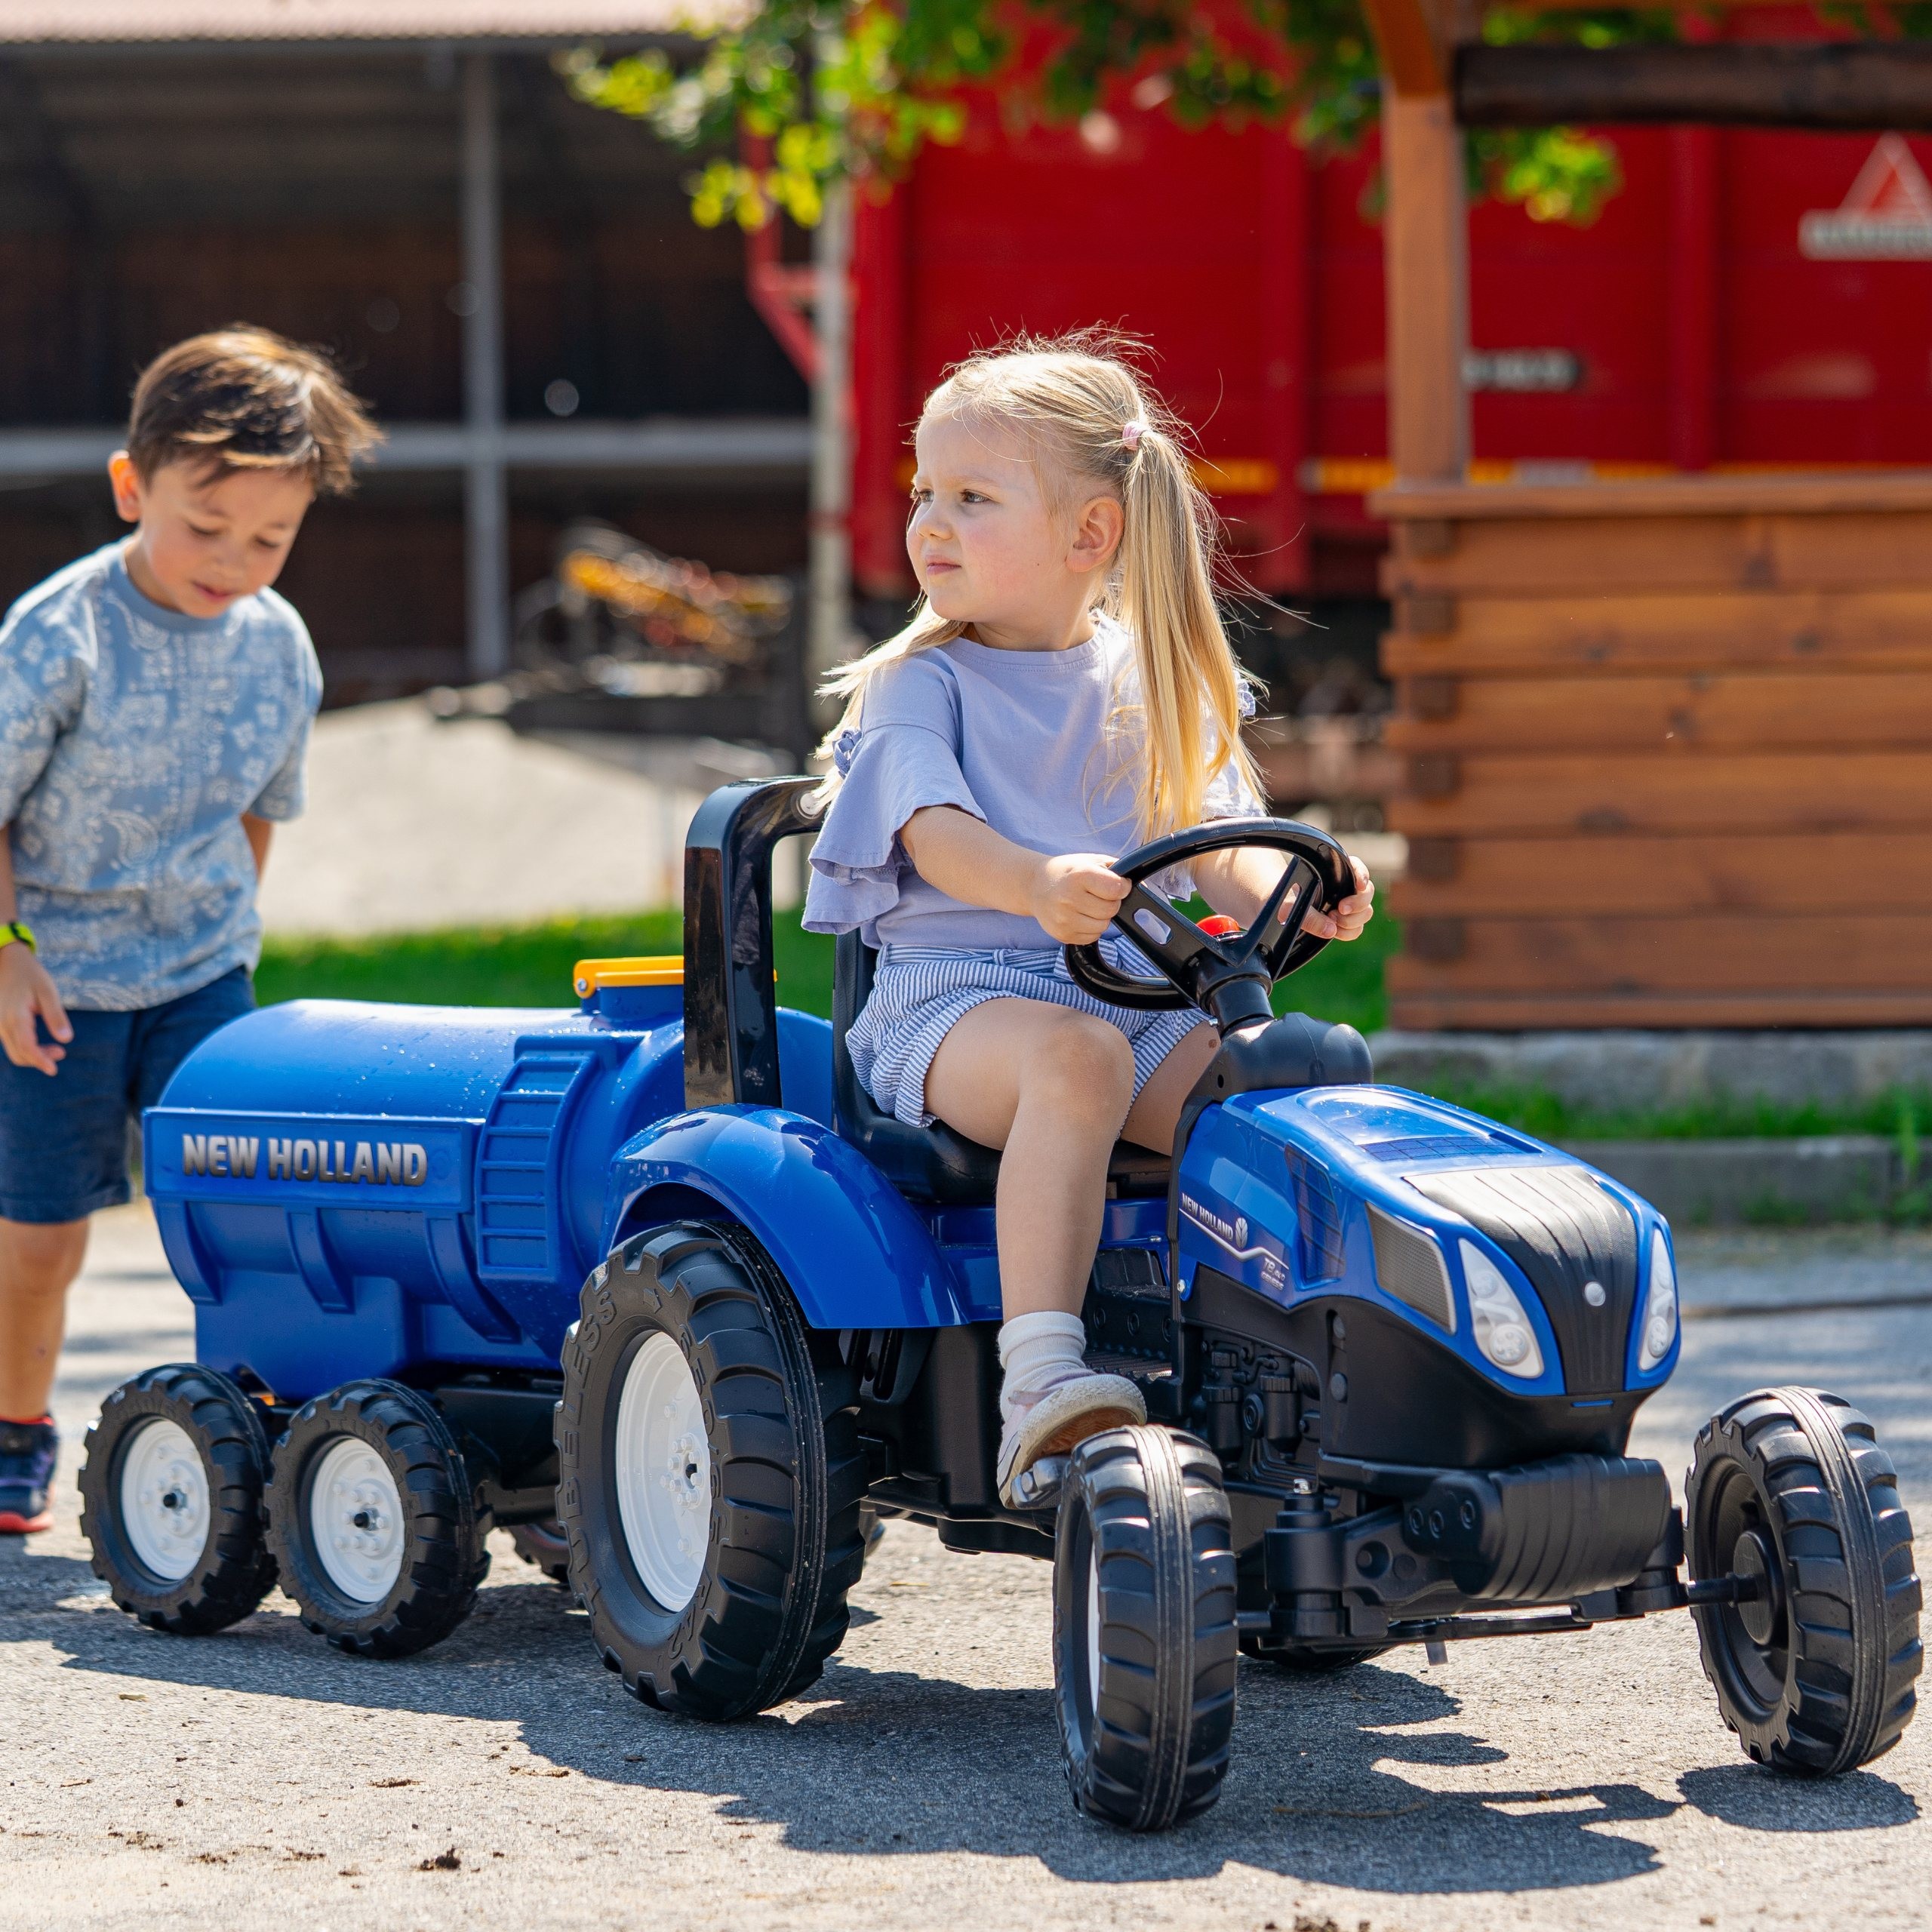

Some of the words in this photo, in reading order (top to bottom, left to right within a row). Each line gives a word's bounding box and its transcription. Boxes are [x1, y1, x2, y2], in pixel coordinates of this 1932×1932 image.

[183, 1134, 260, 1178] NEW
[268, 1137, 428, 1186] HOLLAND
[1182, 1192, 1198, 1217] NEW
[1199, 1205, 1234, 1241] HOLLAND
[565, 1291, 617, 1614] TUBELESS
